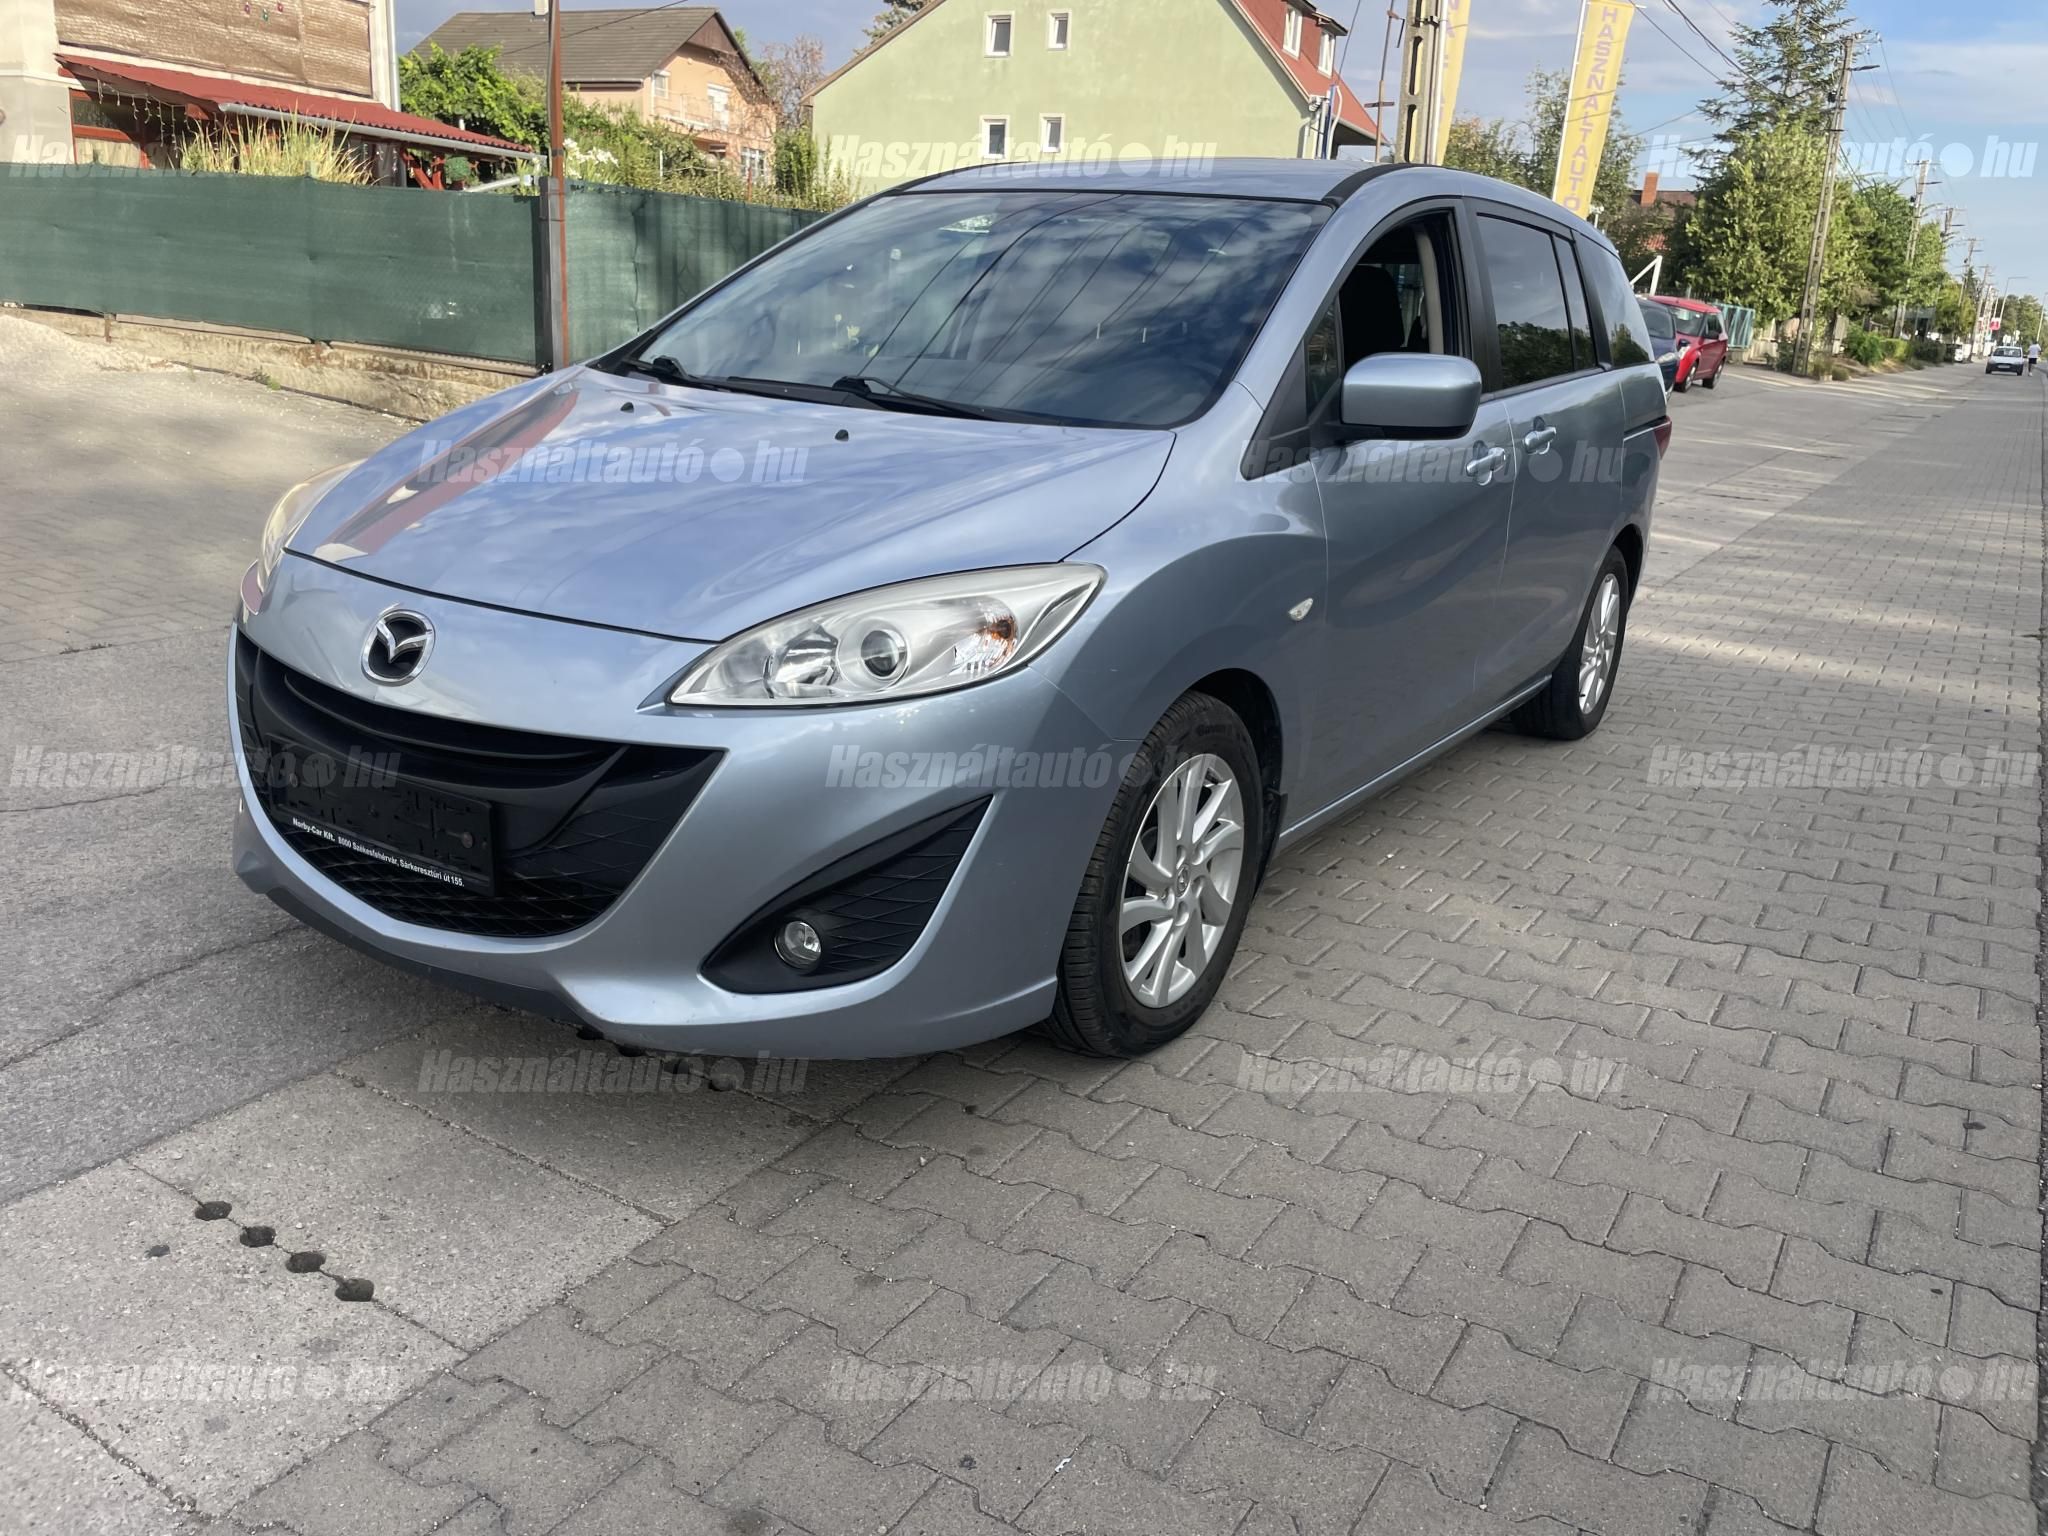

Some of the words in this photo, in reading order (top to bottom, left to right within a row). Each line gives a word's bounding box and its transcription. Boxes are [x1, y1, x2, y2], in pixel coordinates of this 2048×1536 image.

[292, 817, 322, 837] Norby-Car
[323, 830, 336, 841] Kft.
[451, 876, 465, 888] 155.
